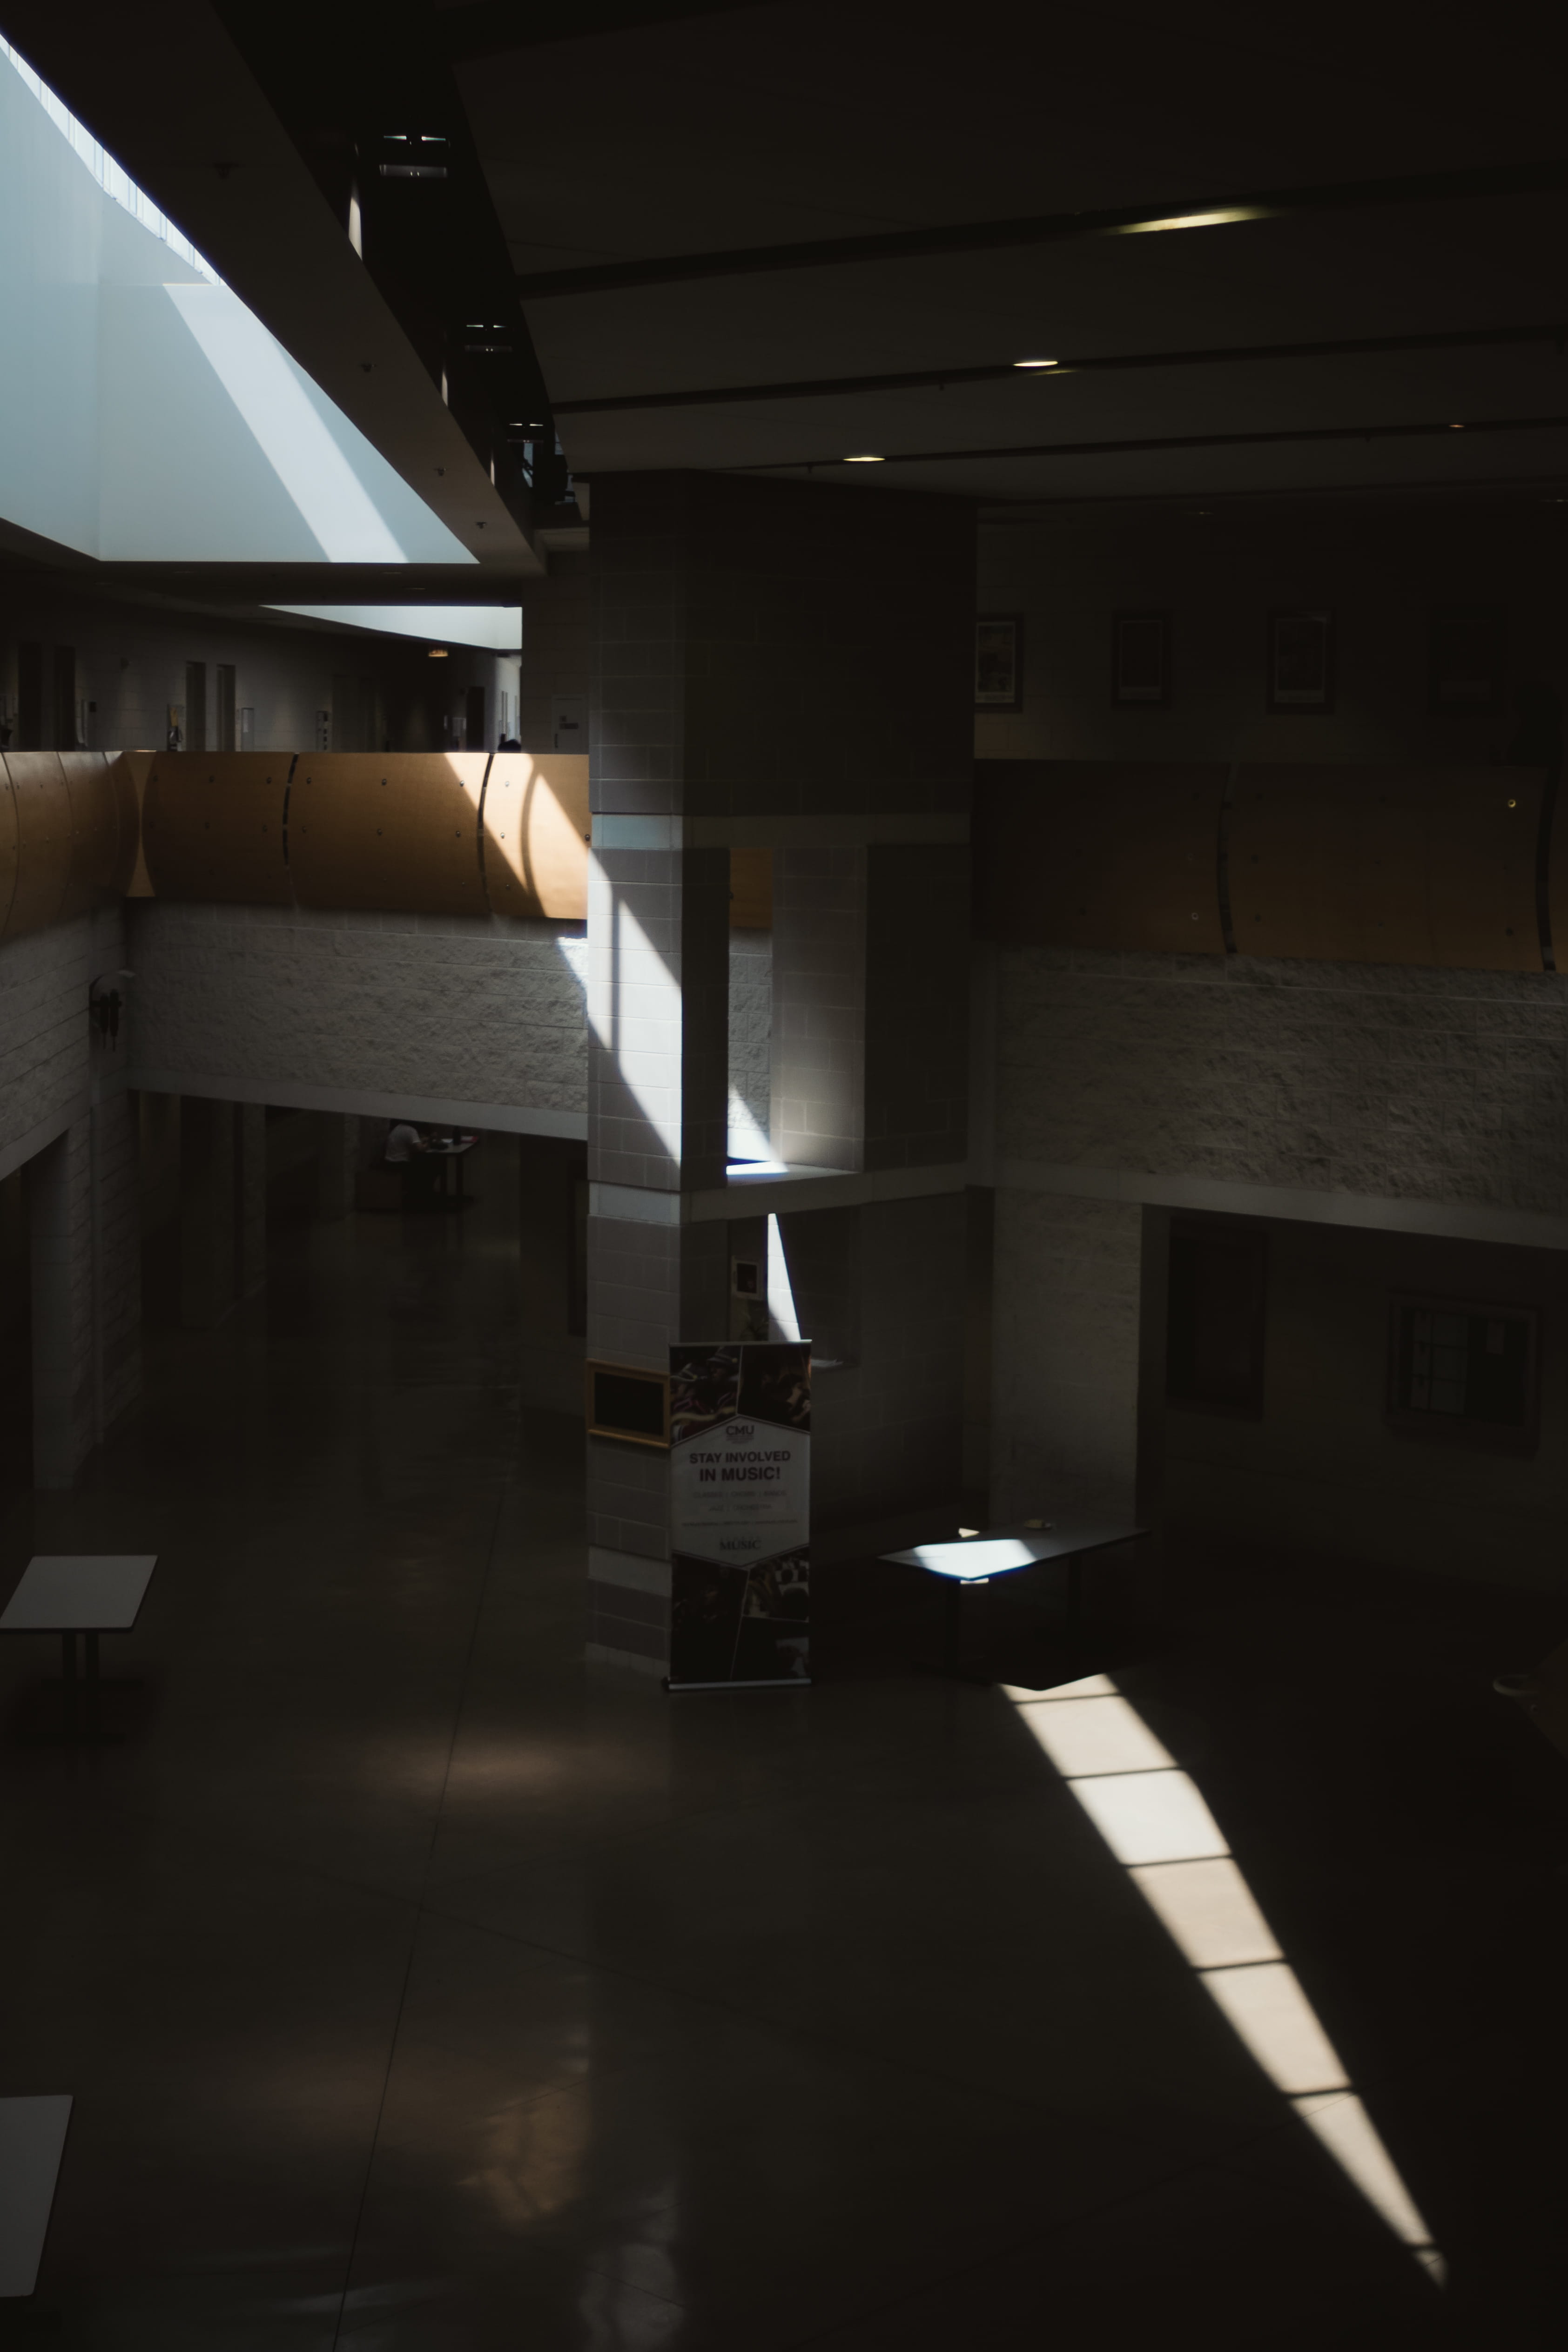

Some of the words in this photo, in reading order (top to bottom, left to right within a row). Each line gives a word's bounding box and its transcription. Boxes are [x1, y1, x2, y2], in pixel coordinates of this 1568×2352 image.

[726, 1425, 754, 1435] CMU
[690, 1453, 722, 1464] STAY
[726, 1451, 791, 1462] INVOLVED
[700, 1469, 716, 1482] IN
[721, 1467, 781, 1481] MUSIC!
[720, 1540, 761, 1550] MUSIC
